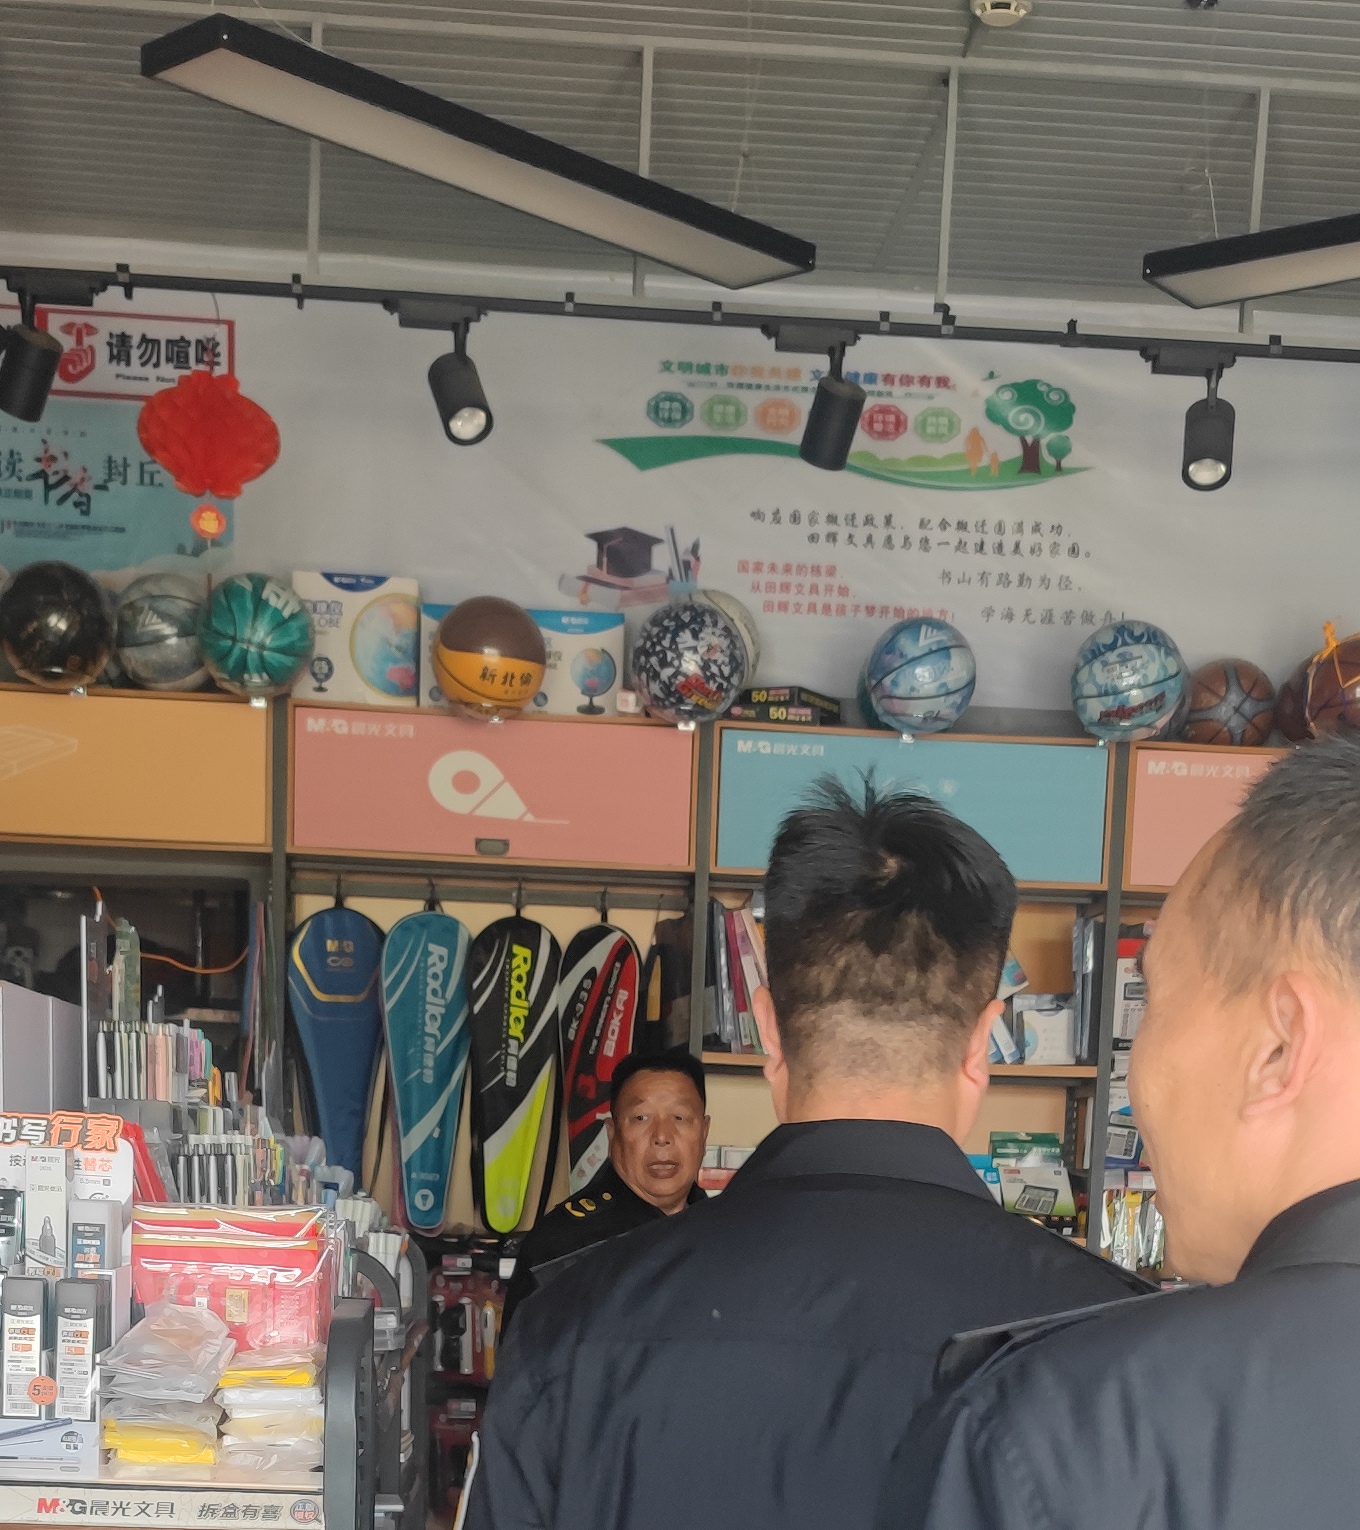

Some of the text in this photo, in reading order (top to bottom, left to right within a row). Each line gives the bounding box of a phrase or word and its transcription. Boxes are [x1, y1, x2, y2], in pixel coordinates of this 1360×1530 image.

[106, 331, 223, 371] 请勿喧哗
[103, 454, 166, 489] 封丘
[750, 688, 769, 705] 50
[768, 706, 787, 723] 50
[304, 716, 415, 739] M&G晨光文具
[35, 1496, 282, 1522] M&G晨光文具 拆盒有喜
